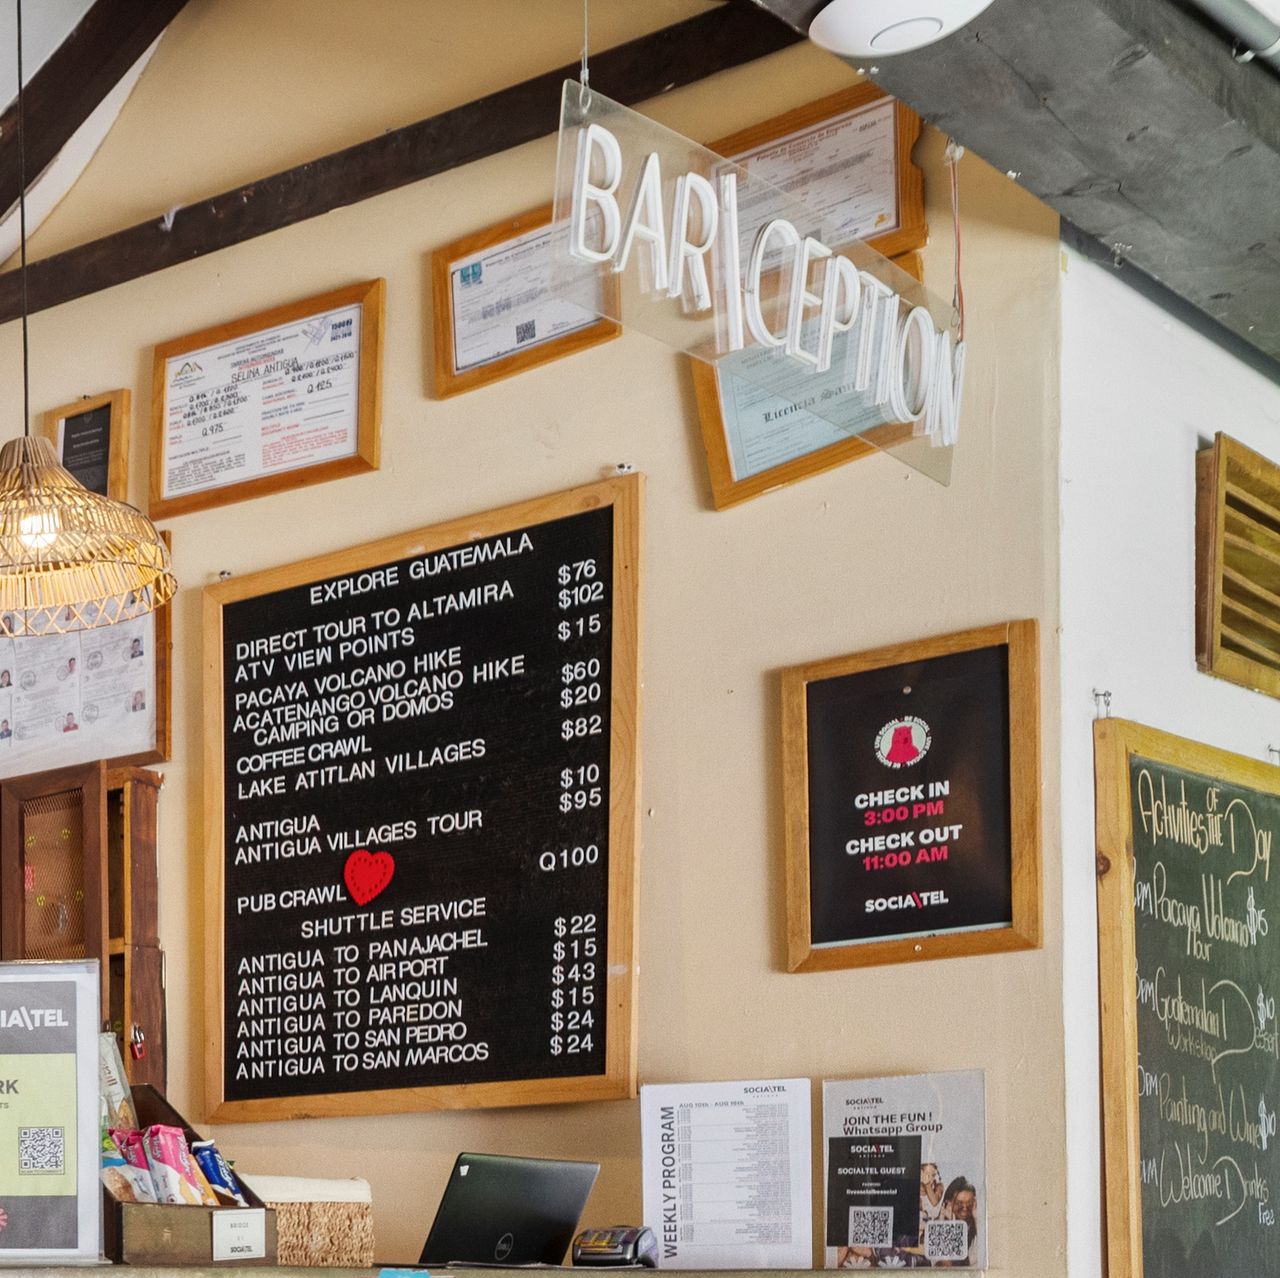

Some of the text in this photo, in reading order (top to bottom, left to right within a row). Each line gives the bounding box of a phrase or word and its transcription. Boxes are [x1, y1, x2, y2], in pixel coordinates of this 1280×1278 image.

[231, 368, 260, 384] SELINA
[310, 532, 534, 605] EXPLORE GUATEMALA
[235, 582, 604, 683] ATV VIEW POINTS $102
[236, 559, 596, 660] DIRECT TOUR TO ALTAMIRA $76
[235, 614, 601, 710] PACAYA VOLCANO HIKE $15
[233, 655, 600, 733] ACATENANGO VOLCANO HIKE $60
[253, 683, 600, 746] CAMPING OR DOMOS $20
[237, 715, 601, 775] COFFEE CRAWL $82
[239, 739, 600, 799] LAKE ATITLAN VILLAGES $10
[235, 788, 601, 843] ANTIGUA $95
[854, 780, 949, 809] CHECK IN
[864, 800, 944, 826] 3:00 PM
[235, 810, 482, 865] ANTIGUA VILLAGES TOUR
[846, 825, 962, 855] CHECK OUT
[1138, 769, 1271, 886] Activities OF THE Day
[539, 845, 598, 871] Q100
[863, 846, 948, 871] 11:00 AM
[238, 885, 346, 914] PUB CRAWL
[301, 898, 486, 938] SHUTTLE SERVICE
[1153, 861, 1201, 955] Pacaya
[1202, 874, 1248, 947] Volcano
[238, 915, 596, 974] ANTIGUA TO PANAJACHEL $22
[238, 939, 596, 995] ANTIGUA TO AIRPORT $15
[237, 963, 595, 1017] ANTIGUA TO LANQUIN $43
[237, 986, 594, 1038] ANTIGUA TO PAREDON $15
[1156, 966, 1219, 1038] Guatemalan
[236, 1034, 593, 1080] ANTIGUA TO SAN MARCOS $24
[237, 1010, 594, 1059] ANTIGUA TO SAN PEDRO $24
[843, 1113, 926, 1126] JOIN THE FUN
[843, 1123, 942, 1135] Whatsapp Group
[1159, 1072, 1207, 1165] Painting
[1208, 1081, 1226, 1135] and
[660, 1106, 678, 1260] WEEKLY PROGRAM
[838, 1167, 878, 1175] SOCIALTEL
[1160, 1141, 1269, 1226] Welcome Drinks
[1258, 1202, 1275, 1226] Free
